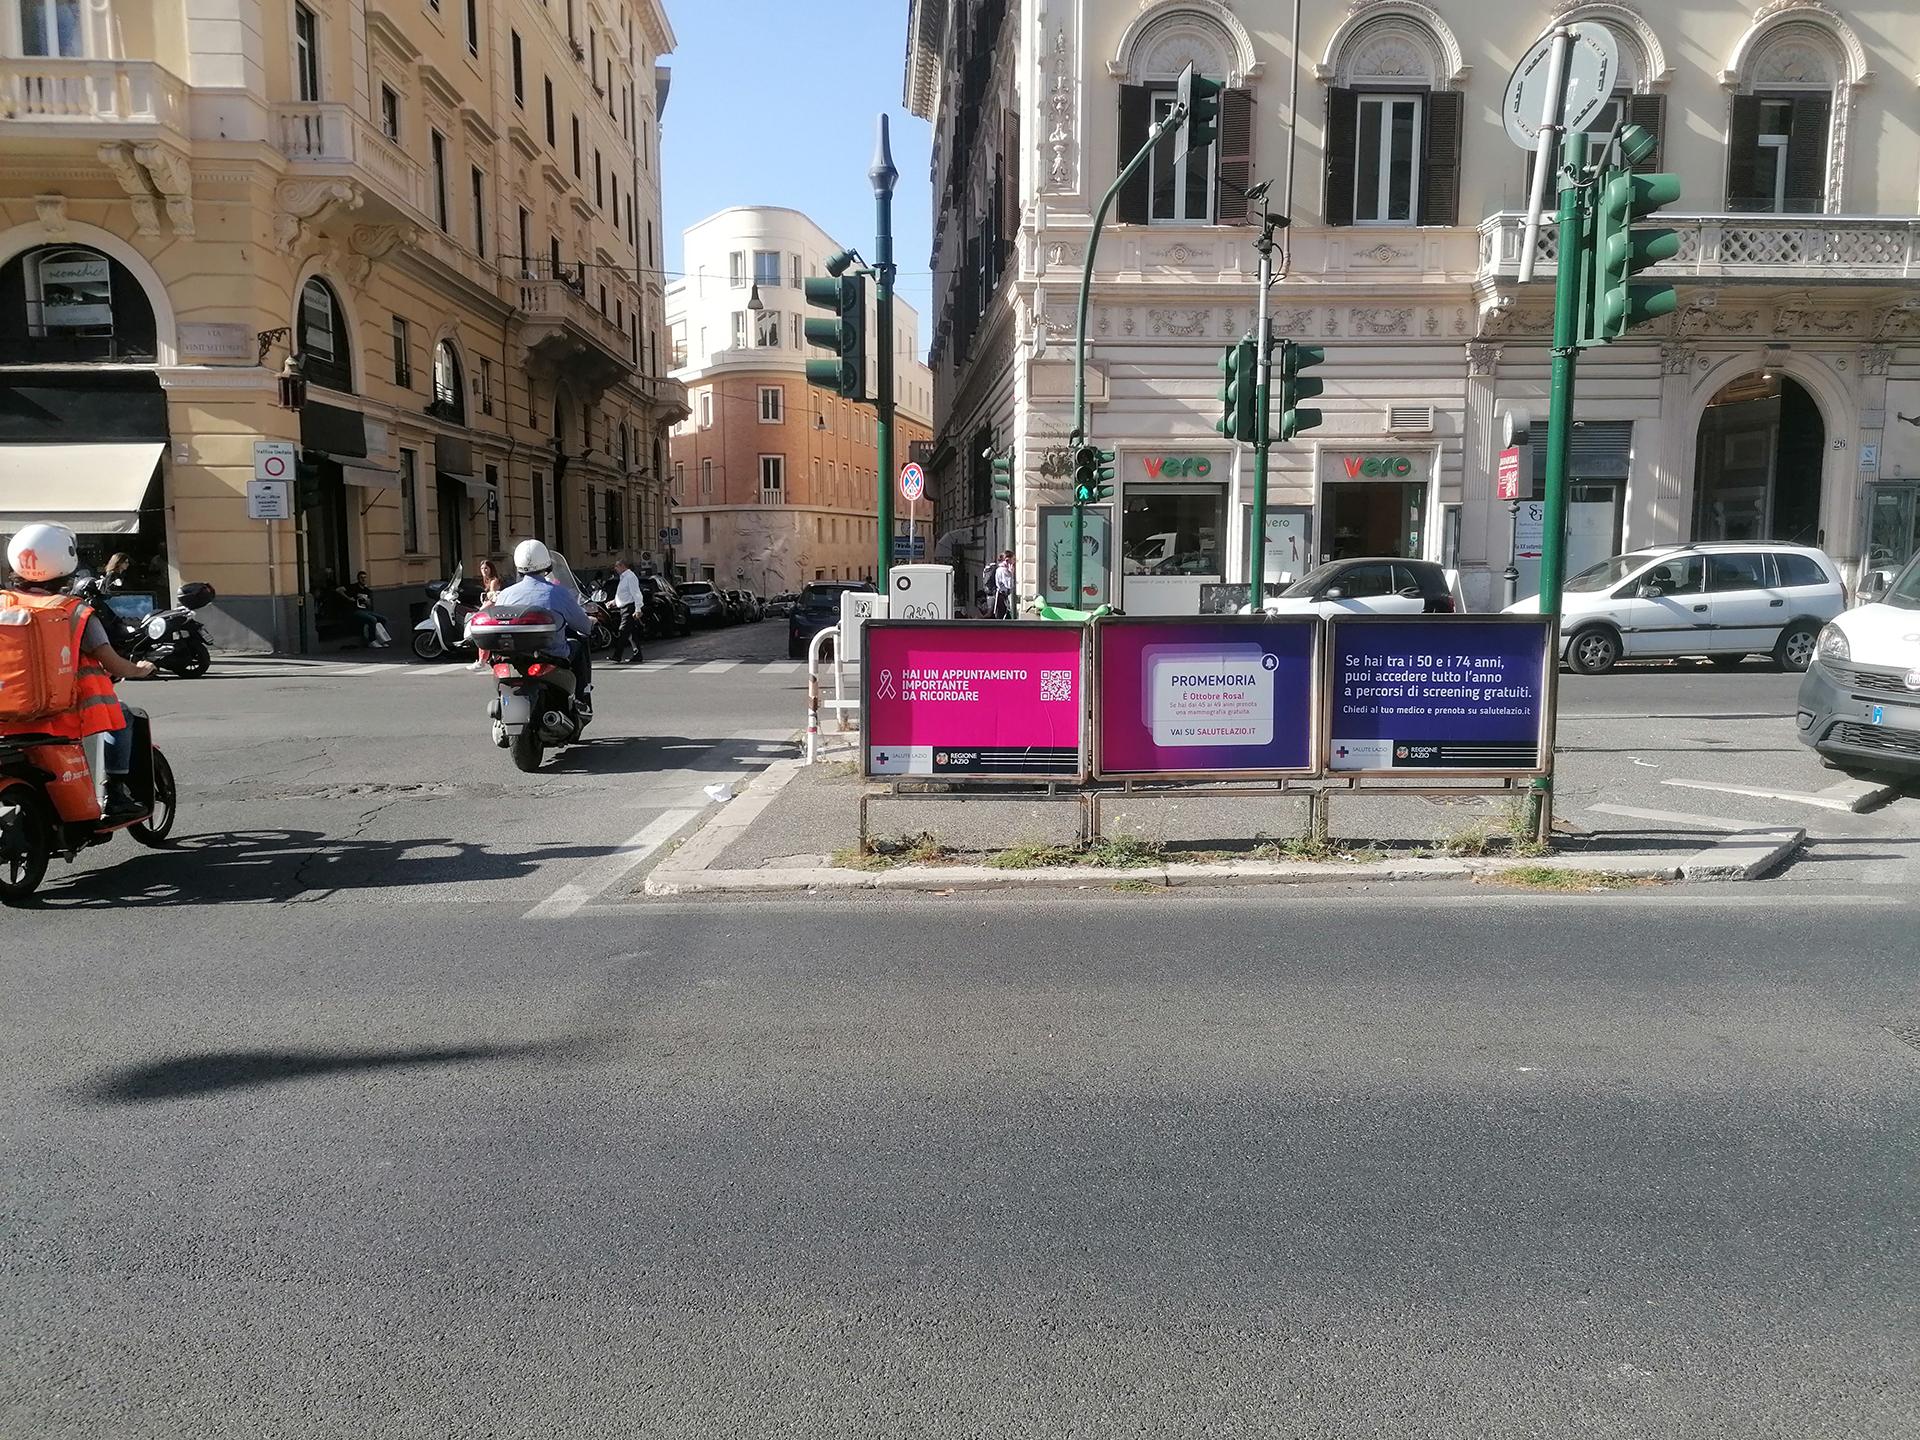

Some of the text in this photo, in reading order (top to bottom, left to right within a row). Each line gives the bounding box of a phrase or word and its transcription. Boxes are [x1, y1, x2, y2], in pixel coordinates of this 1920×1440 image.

[1833, 440, 1846, 449] 26
[1345, 655, 1504, 669] Se hai tra i 50 e i 74 anni,
[902, 669, 1027, 680] HAI UN APPUNTAMENTO
[1171, 674, 1256, 686] PROMEMORIA
[1345, 670, 1371, 684] puoi
[1375, 670, 1427, 682] accedere
[1431, 671, 1461, 682] tutto
[902, 680, 969, 690] IMPORTANTE
[902, 690, 979, 701] DA RICORDARE
[1190, 692, 1220, 700] Ottobre
[1222, 692, 1245, 700] Rosa!
[1344, 685, 1532, 701] a percorsi di screening gratuiti.
[1227, 708, 1250, 716] gratuita
[1343, 705, 1368, 713] Chiedi
[1434, 707, 1465, 716] prenota
[1480, 707, 1531, 715] salutelazio.it
[1197, 728, 1256, 736] SALUTELAZIO.IT
